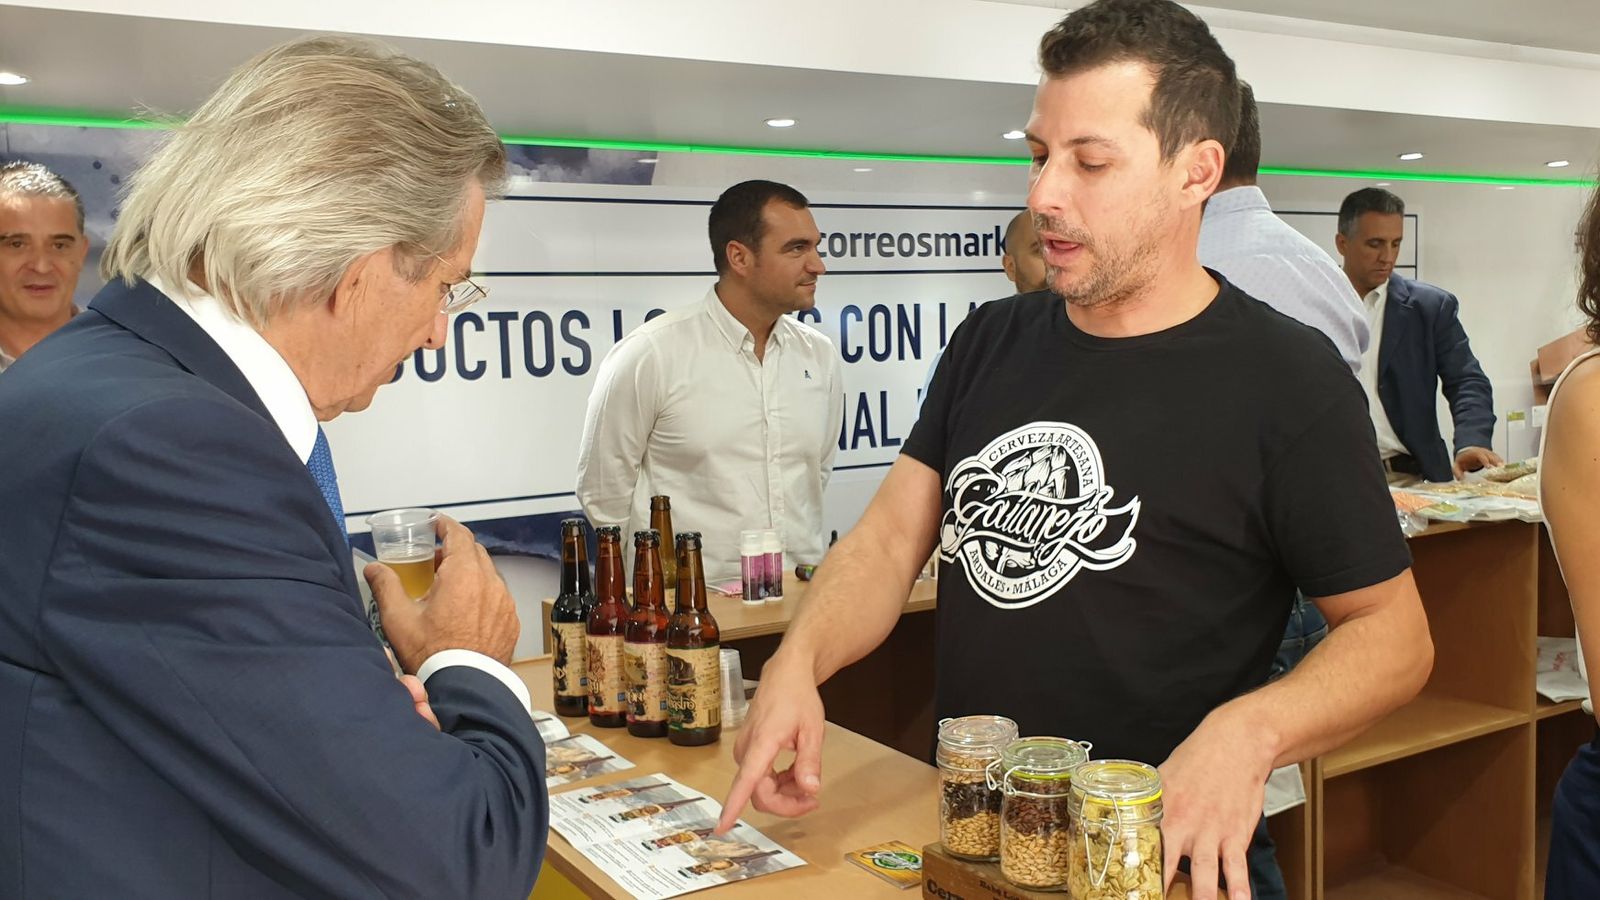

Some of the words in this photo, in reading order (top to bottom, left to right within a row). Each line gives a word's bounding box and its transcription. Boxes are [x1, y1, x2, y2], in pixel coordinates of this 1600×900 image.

[840, 304, 922, 363] CON
[988, 433, 1054, 462] CERVEZA
[1055, 433, 1094, 488] ARTESANA
[969, 549, 1007, 593] ARDALES
[1012, 557, 1068, 595] MÁLAGA
